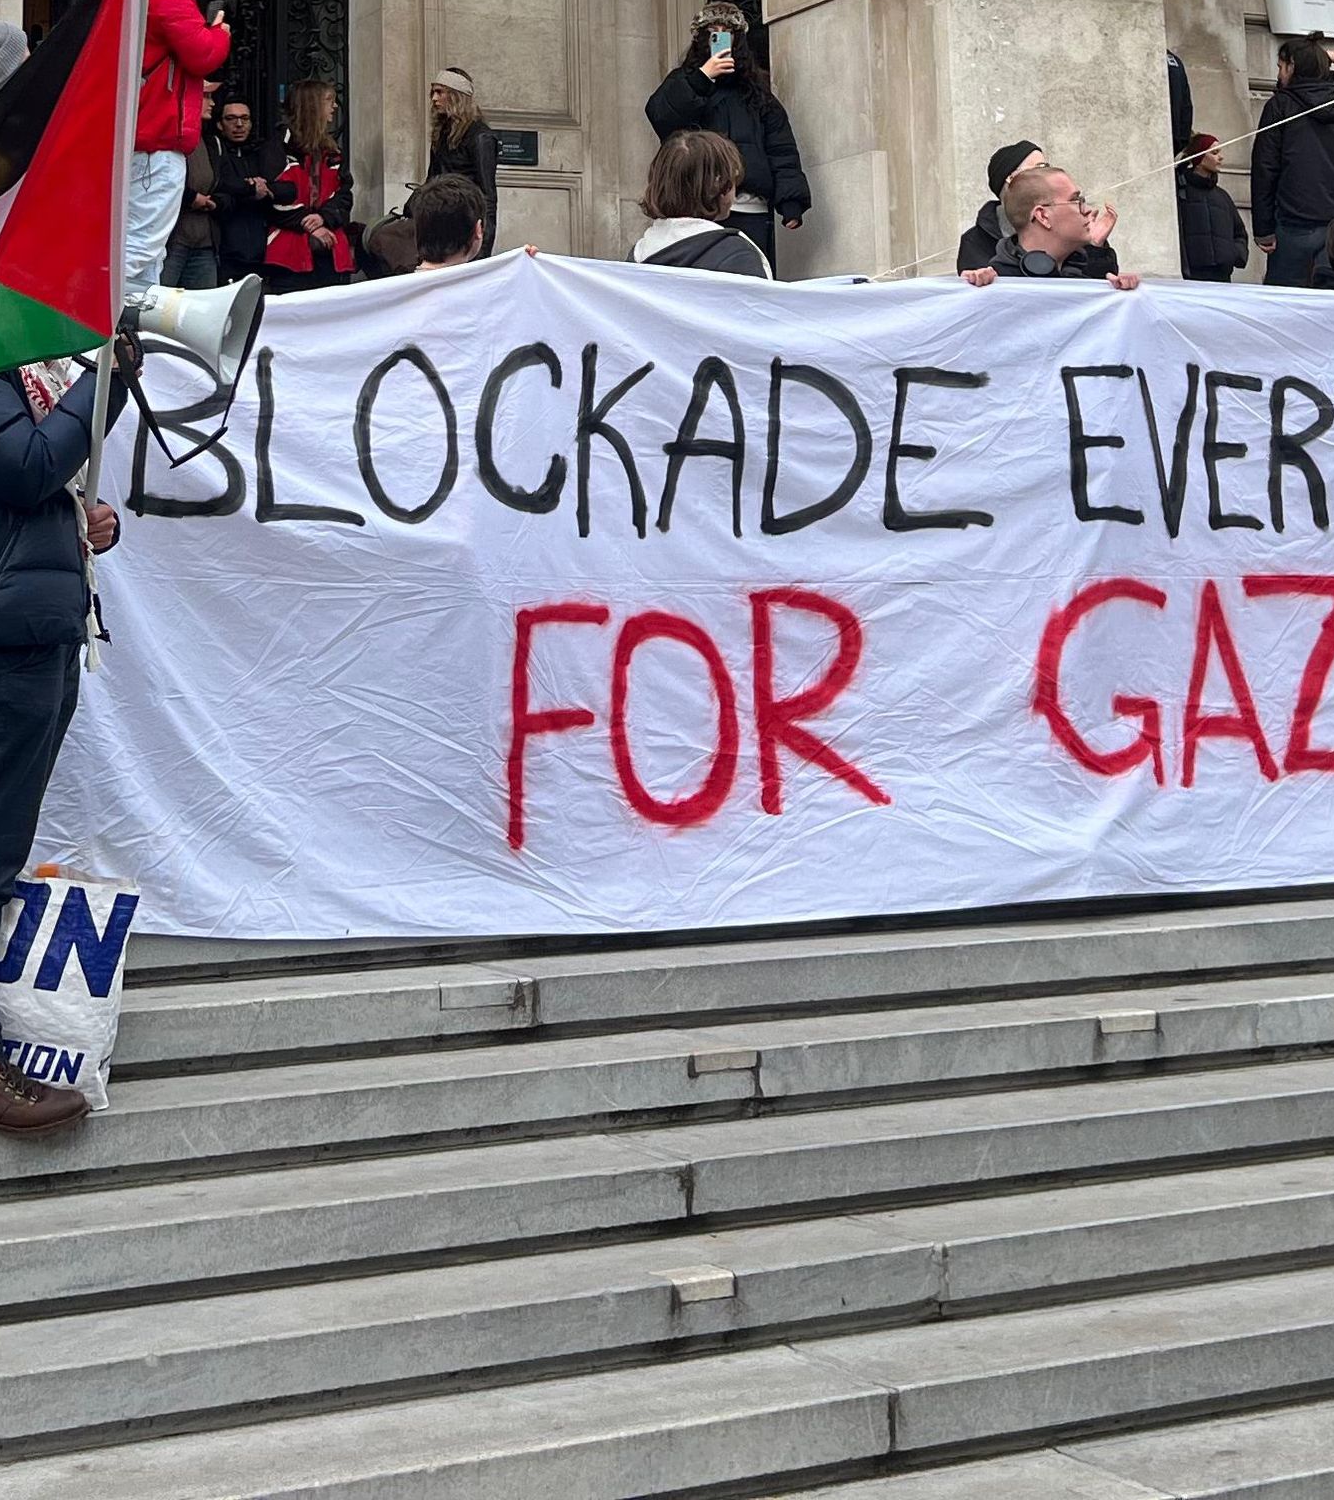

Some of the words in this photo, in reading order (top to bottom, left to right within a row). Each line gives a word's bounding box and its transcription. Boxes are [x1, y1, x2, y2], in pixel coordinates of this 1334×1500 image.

[126, 336, 995, 540] BLOCKADE
[507, 584, 893, 852] FOR
[2, 1039, 85, 1085] TION
